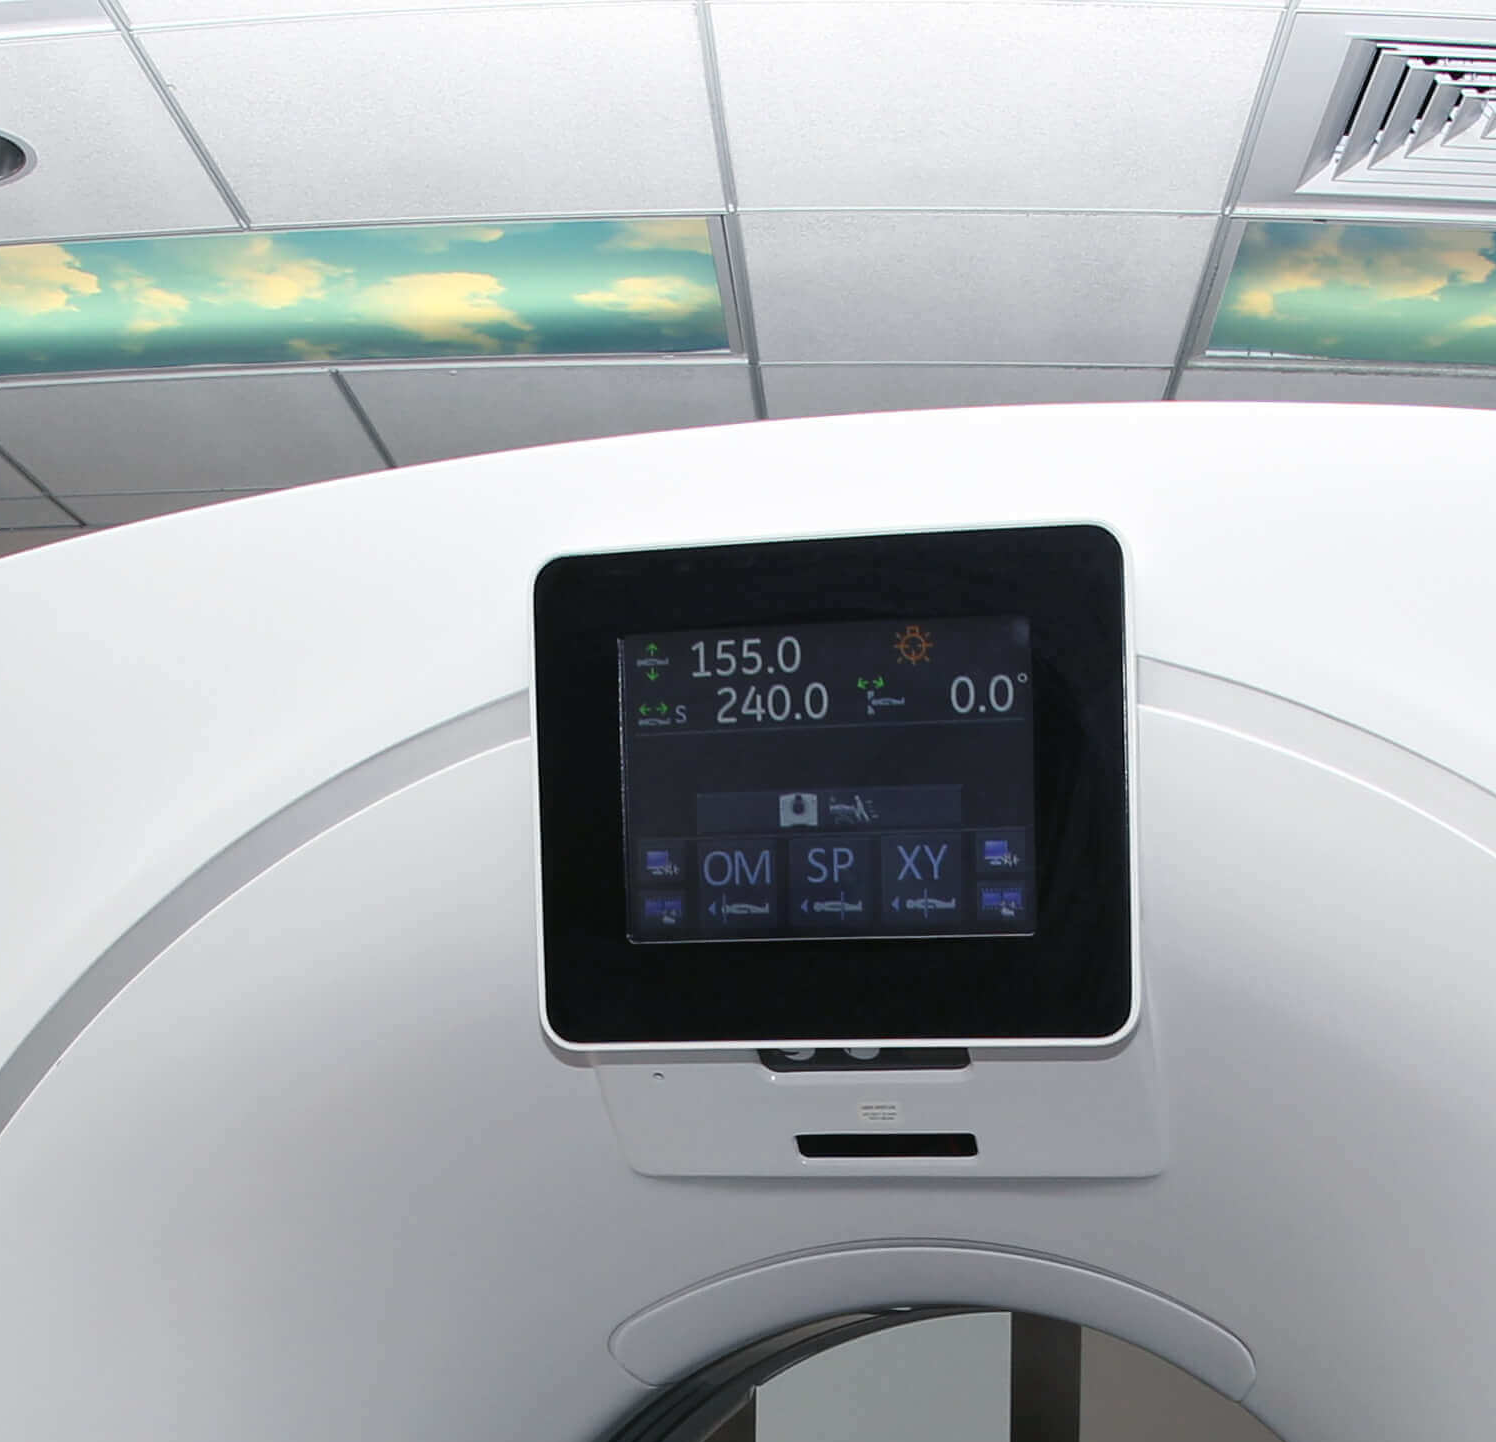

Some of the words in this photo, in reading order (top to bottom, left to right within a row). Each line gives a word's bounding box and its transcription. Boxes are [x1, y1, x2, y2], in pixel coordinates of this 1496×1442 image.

[690, 636, 802, 678] 155.0
[674, 704, 687, 724] S
[716, 682, 829, 724] 240.0
[703, 850, 772, 886] OM
[806, 847, 855, 883] SP
[896, 844, 948, 881] XY
